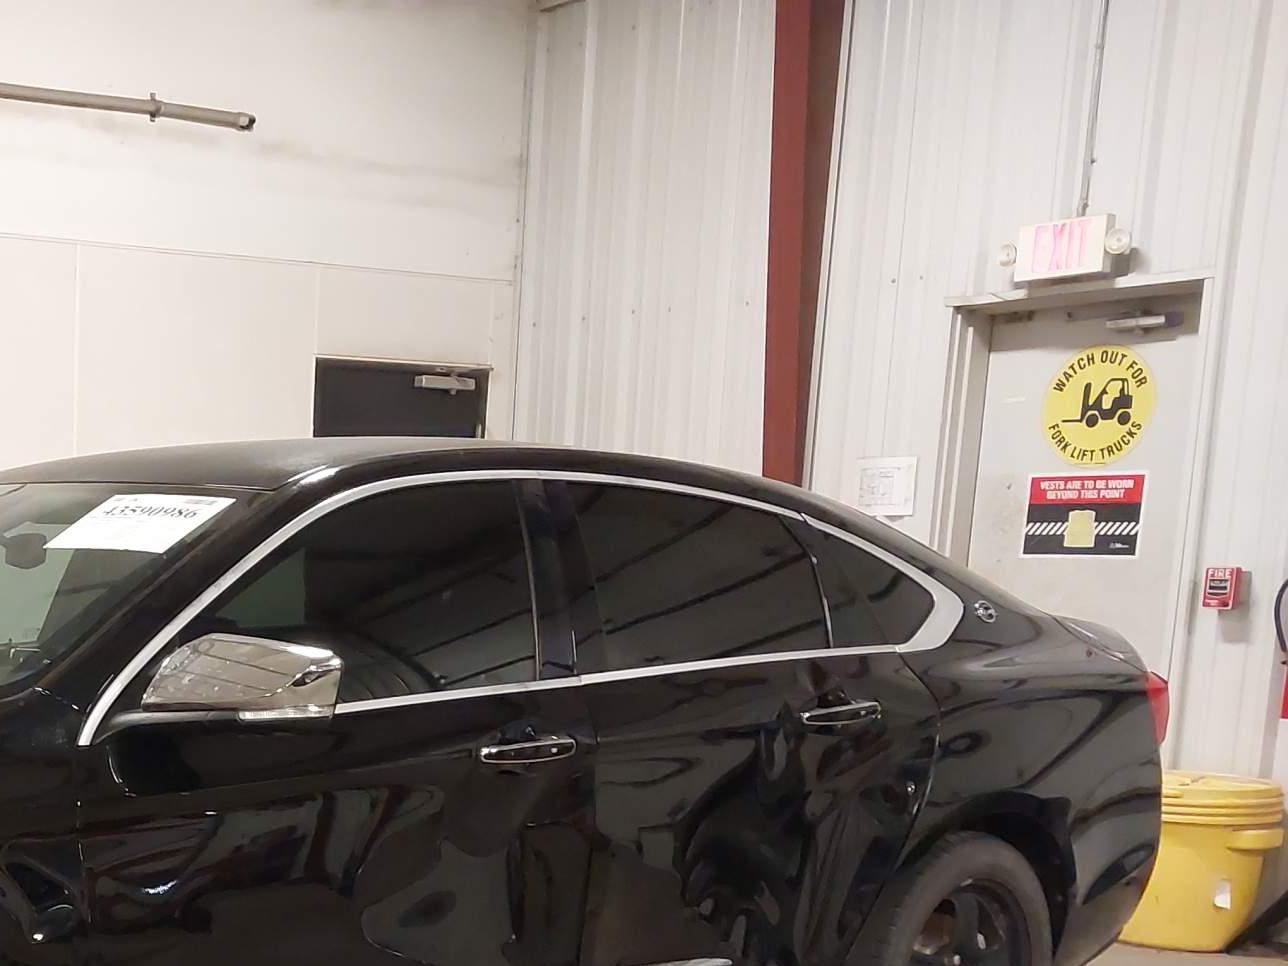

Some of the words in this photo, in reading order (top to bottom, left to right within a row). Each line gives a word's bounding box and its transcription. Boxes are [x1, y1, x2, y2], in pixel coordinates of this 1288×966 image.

[1032, 219, 1091, 273] EXIT
[1053, 353, 1095, 392] WATCH
[1100, 350, 1128, 366] OUT
[1126, 360, 1148, 388] FOR
[1048, 423, 1072, 454] FORK
[1070, 446, 1096, 462] LIFT
[1098, 420, 1142, 460] TRUCKS
[1040, 481, 1065, 490] VESTS
[1066, 480, 1083, 490] ARE
[1084, 480, 1095, 489] TO
[1096, 480, 1107, 489] BE
[1108, 479, 1135, 489] WORN
[1046, 490, 1079, 500] BEYOND
[1080, 489, 1098, 499] THIS
[1100, 489, 1125, 499] POINT
[103, 505, 198, 519] 43590986
[1209, 568, 1232, 578] FIRE
